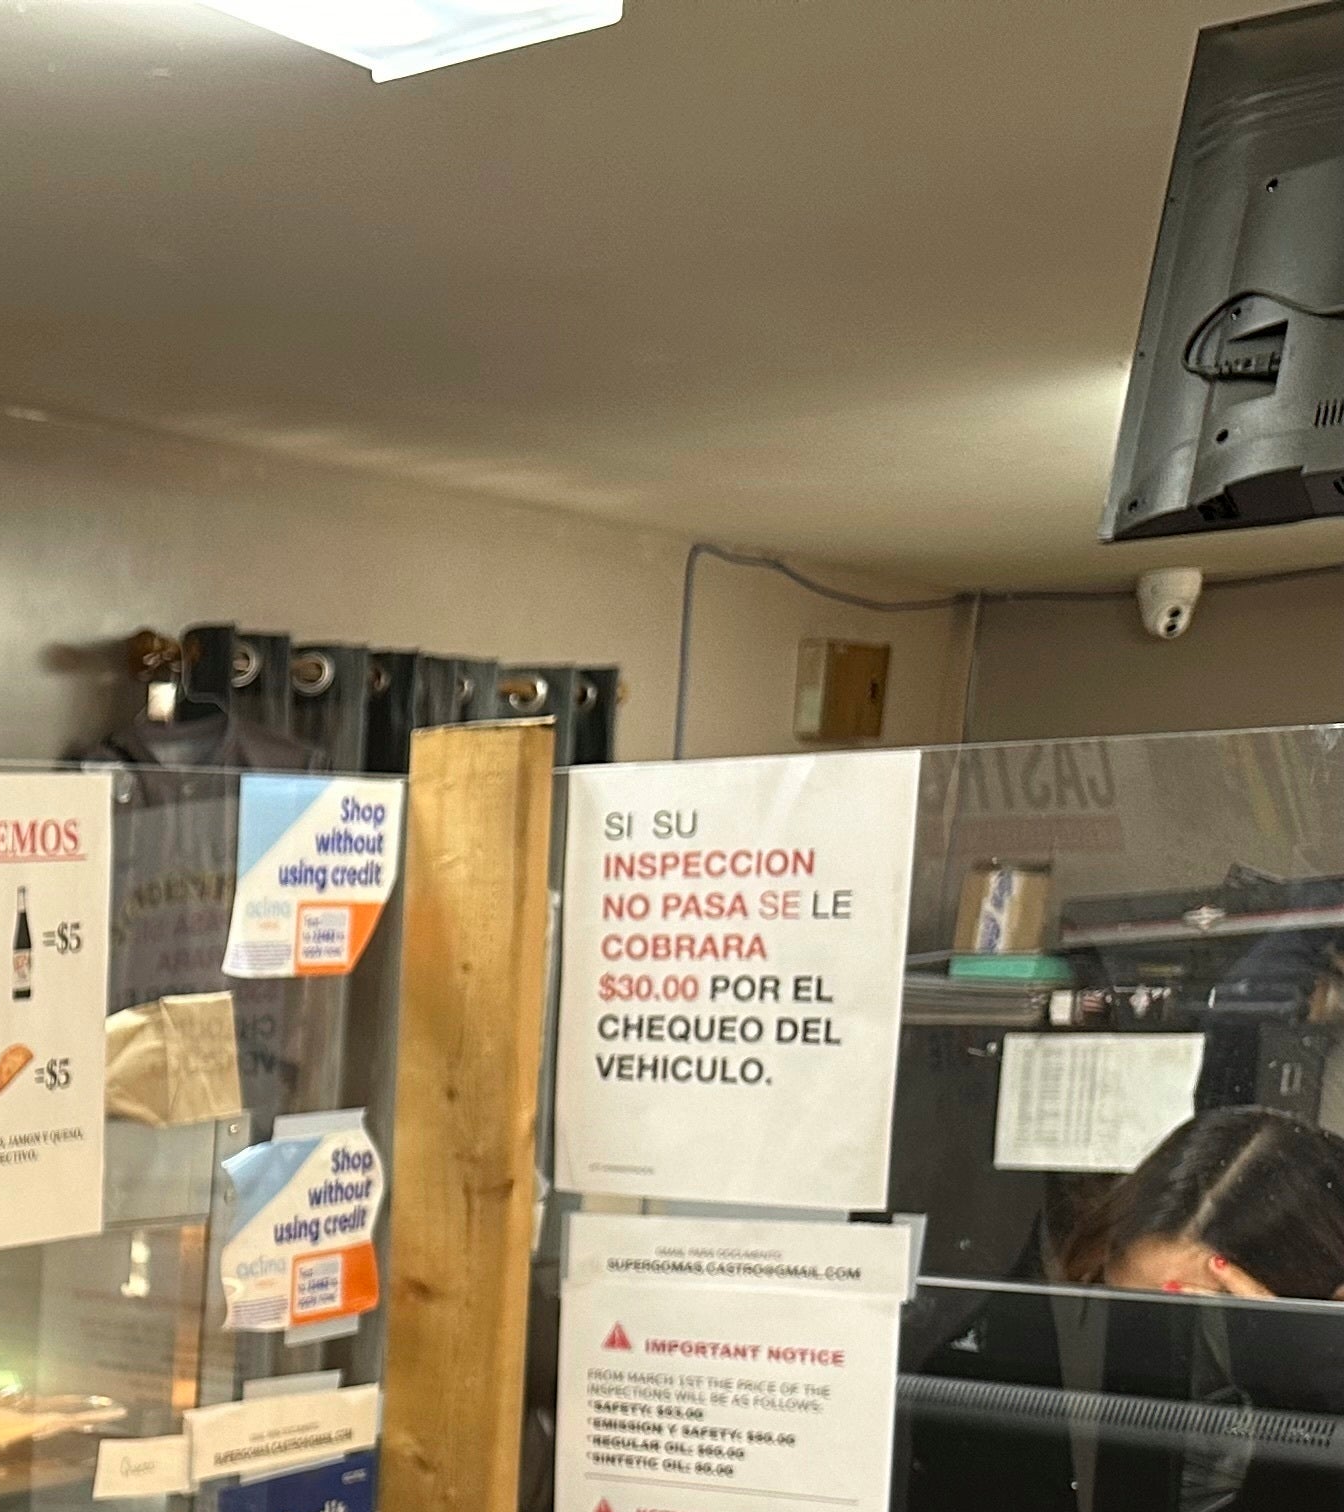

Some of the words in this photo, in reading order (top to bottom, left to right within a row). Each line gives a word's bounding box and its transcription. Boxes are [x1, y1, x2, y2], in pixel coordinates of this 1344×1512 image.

[341, 795, 385, 828] Shop
[604, 811, 633, 841] SI
[653, 809, 697, 839] SU
[316, 826, 383, 854] without
[278, 860, 326, 892] using
[331, 860, 382, 886] credit
[603, 848, 816, 881] INSPECCION
[602, 891, 651, 921] NO
[662, 891, 750, 920] PASA
[759, 890, 802, 920] SE
[811, 889, 853, 920] LE
[601, 932, 768, 962] COBRARA
[598, 971, 700, 1003] $30.00
[710, 974, 782, 1003] POR
[792, 974, 834, 1003] EL
[597, 1013, 764, 1044] CHEQUEO
[775, 1016, 842, 1046] DEL
[596, 1053, 772, 1087] VEHICULO.
[331, 1147, 373, 1174] Shop
[308, 1178, 372, 1207] without
[273, 1214, 320, 1245] using
[323, 1205, 367, 1235] credit
[644, 1338, 760, 1362] IMPORTANT
[767, 1345, 846, 1368] NOTICE
